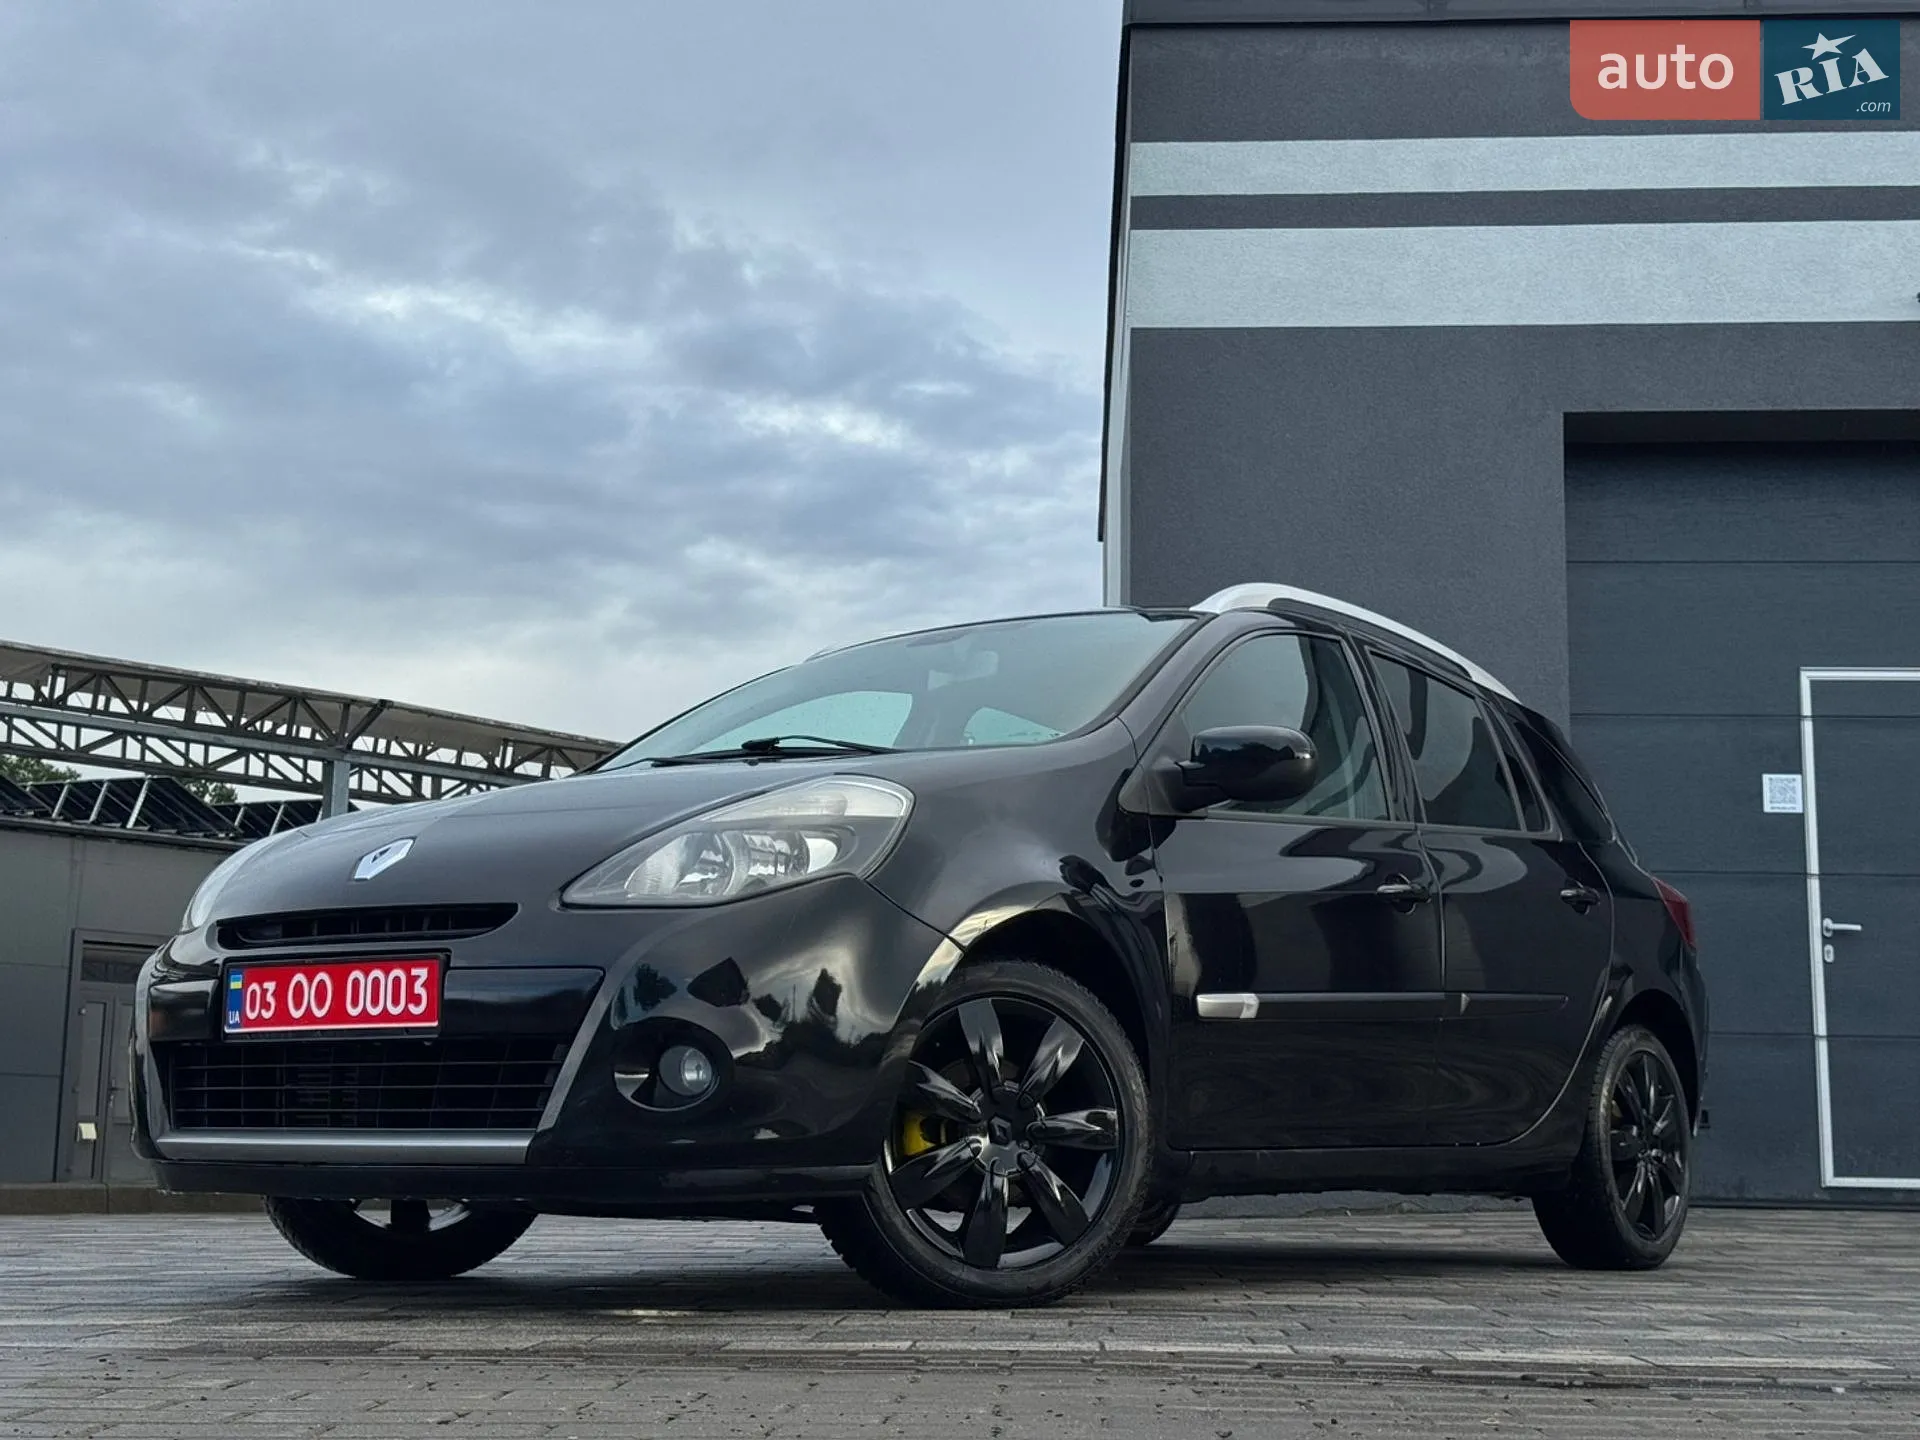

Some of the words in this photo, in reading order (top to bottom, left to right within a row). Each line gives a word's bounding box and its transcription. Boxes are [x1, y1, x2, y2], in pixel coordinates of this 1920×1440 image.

[245, 981, 277, 1020] 03
[346, 967, 429, 1017] 0003
[228, 1011, 241, 1025] UA
